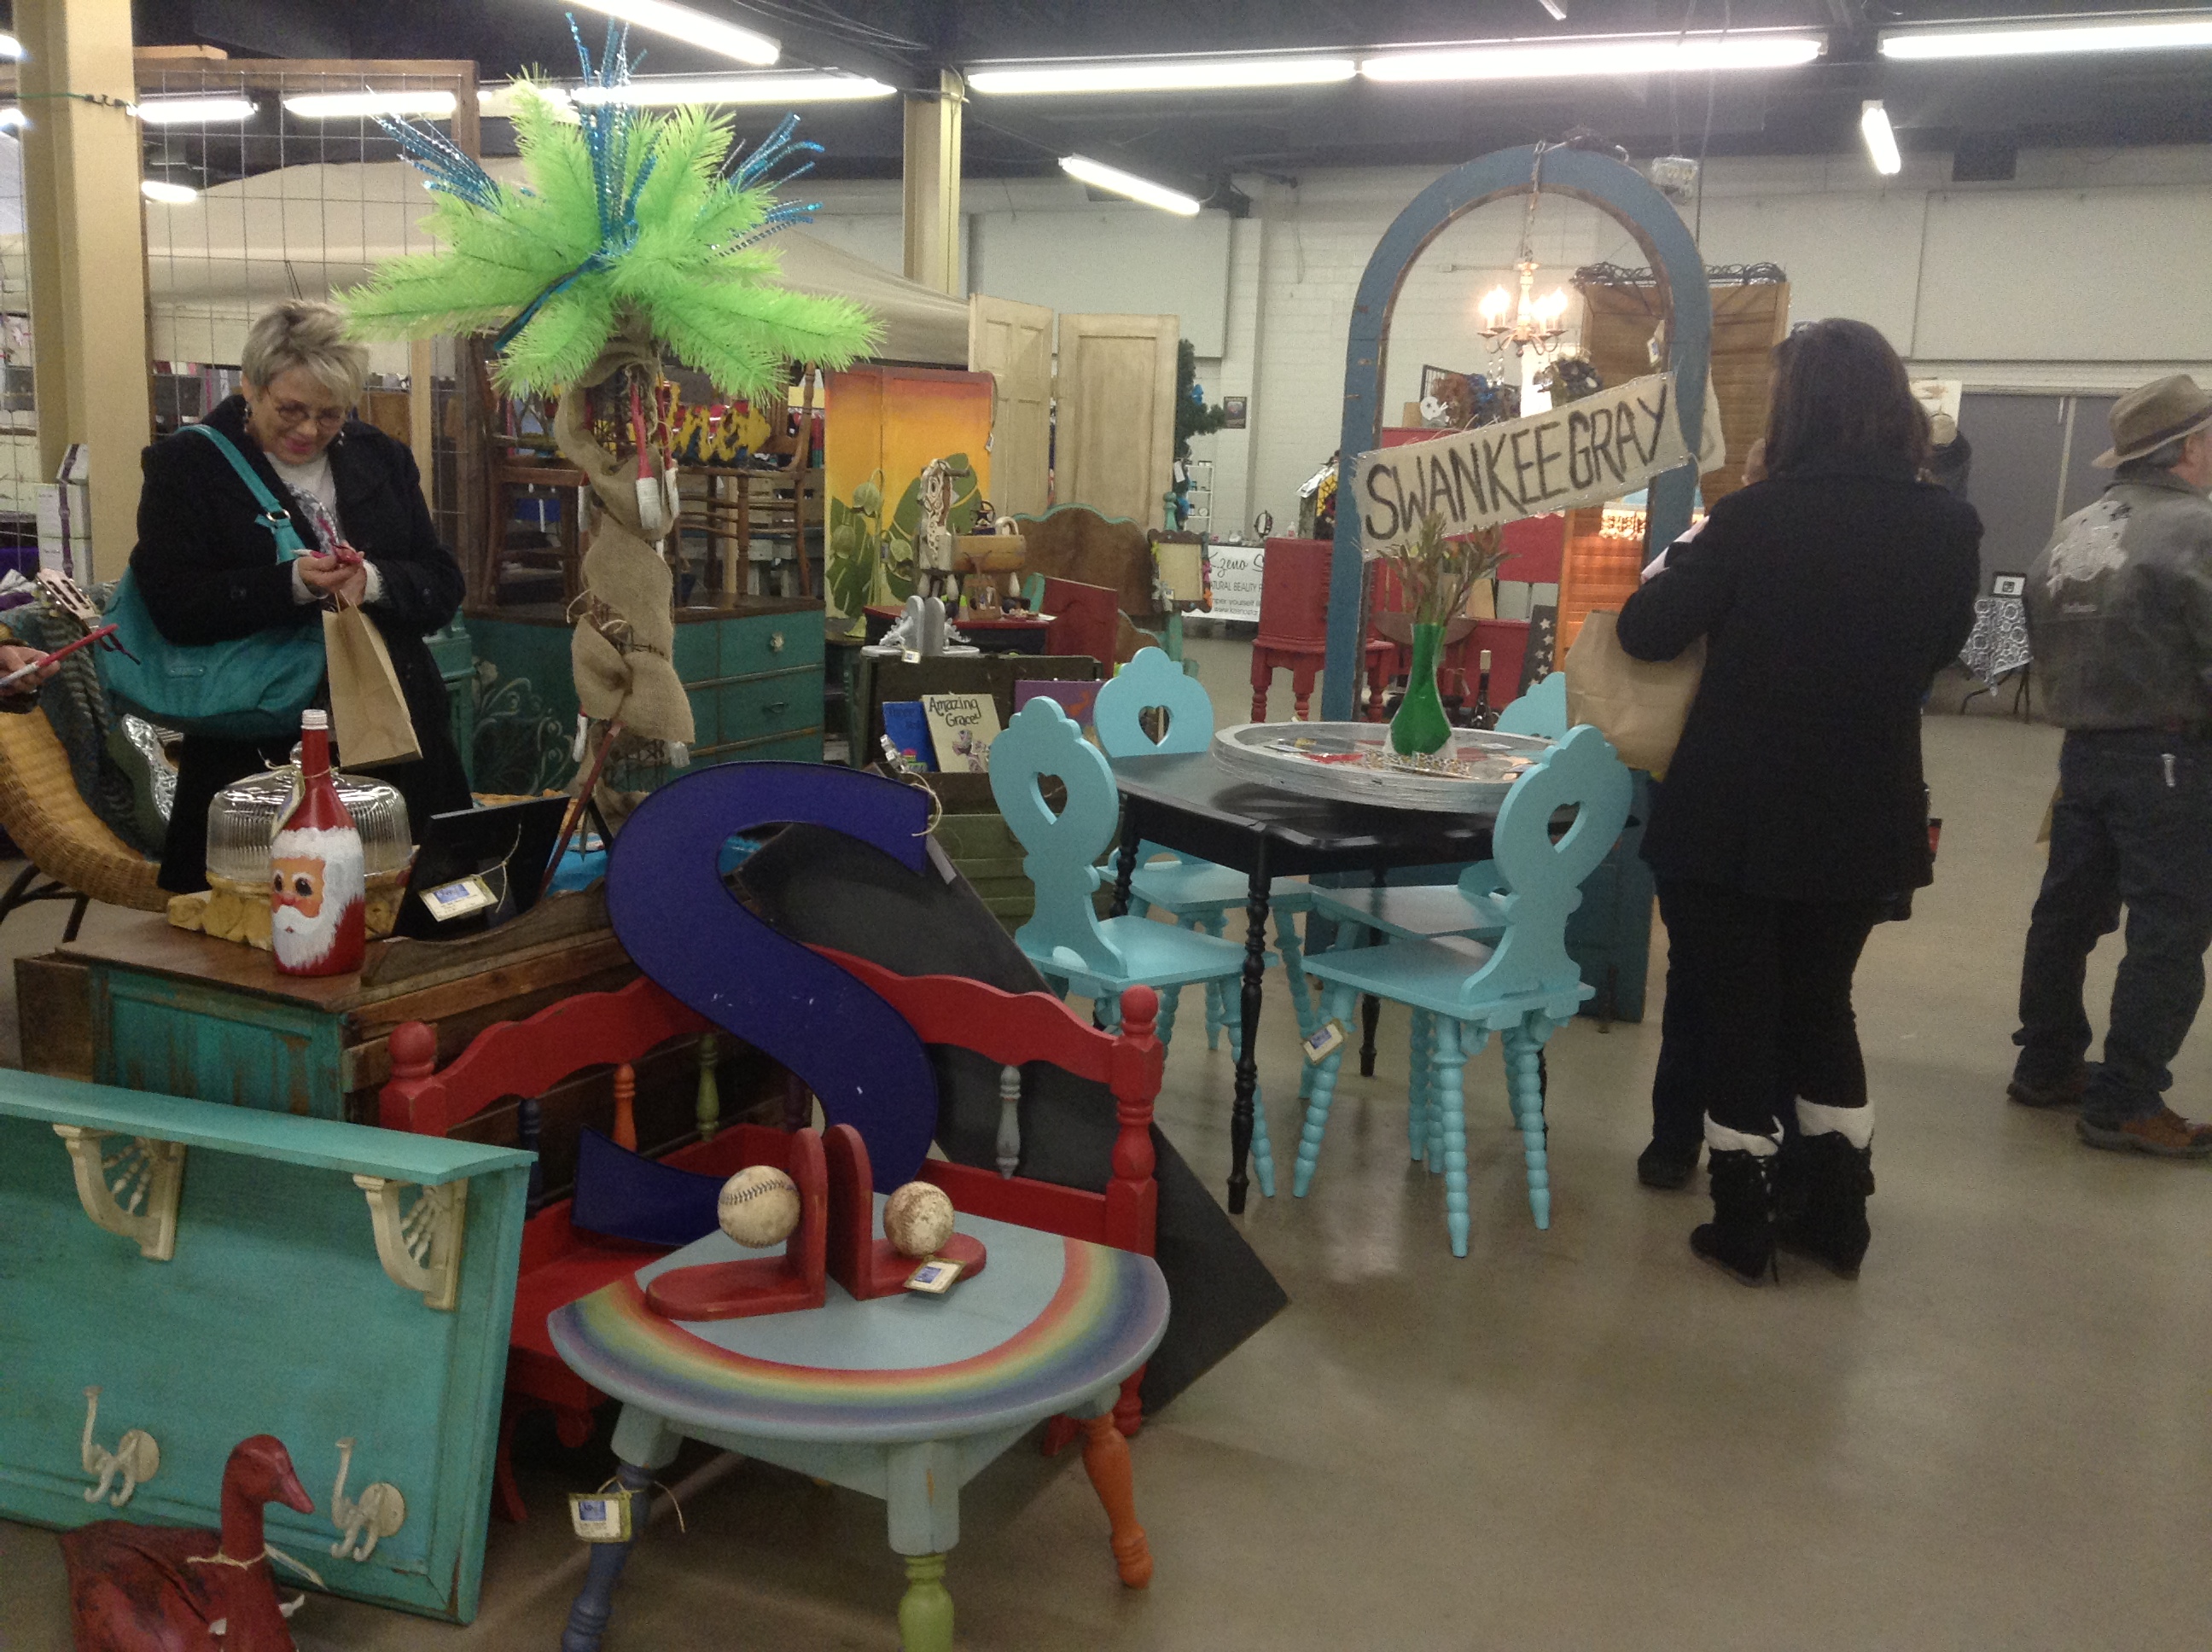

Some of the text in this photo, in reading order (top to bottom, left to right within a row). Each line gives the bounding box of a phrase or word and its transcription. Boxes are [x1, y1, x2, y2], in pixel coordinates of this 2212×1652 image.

[1233, 582, 1258, 592] BEAUTY
[928, 696, 981, 718] Amazing
[945, 713, 979, 727] Grace
